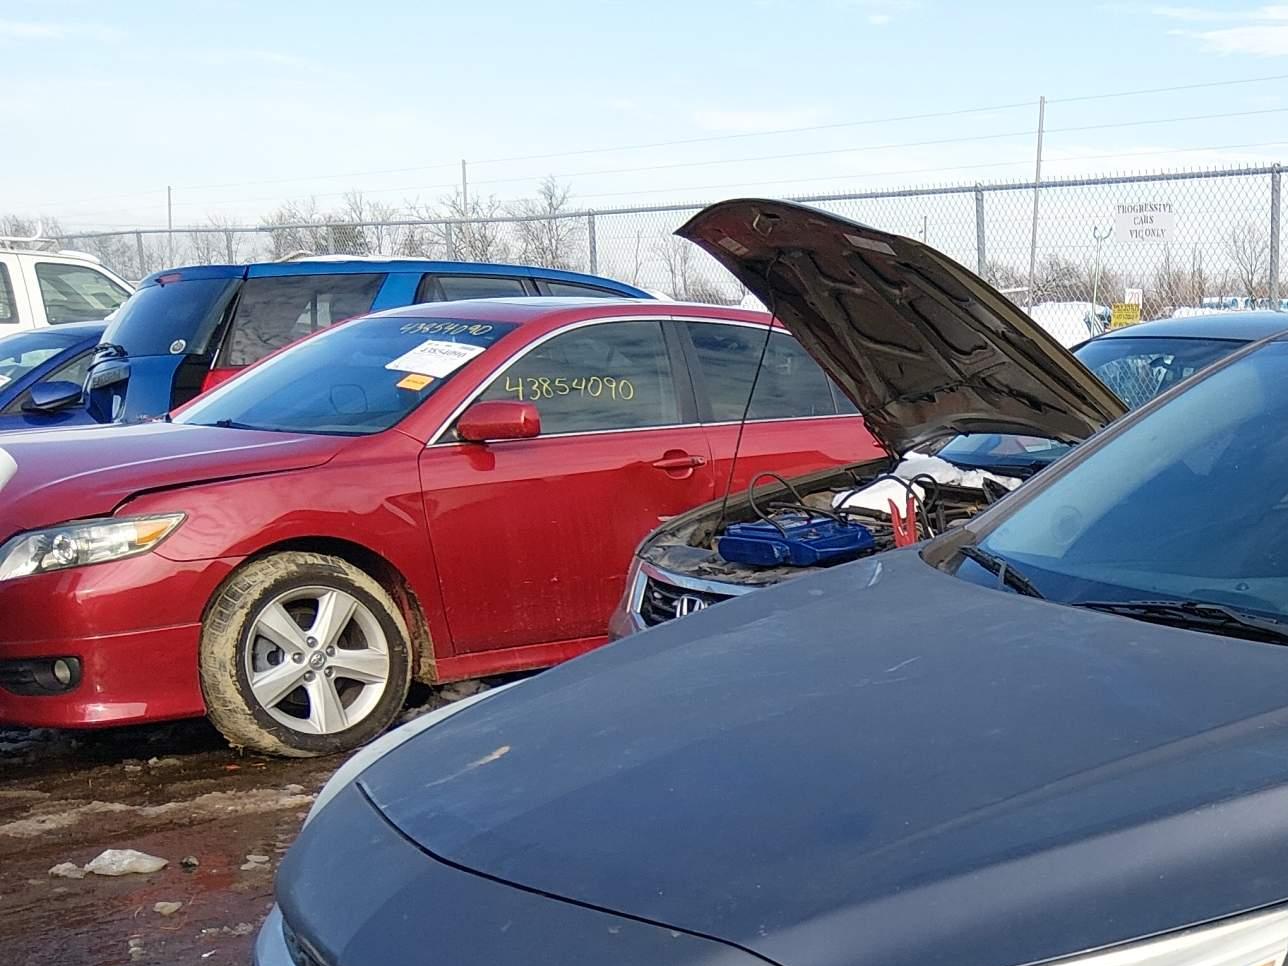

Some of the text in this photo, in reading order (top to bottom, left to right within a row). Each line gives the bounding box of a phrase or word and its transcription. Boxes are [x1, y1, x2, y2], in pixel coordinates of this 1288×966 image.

[1117, 203, 1173, 214] PROGRESSIVE
[1133, 215, 1154, 226] CARS
[1145, 228, 1165, 238] ONLY
[505, 376, 633, 401] 43854090
